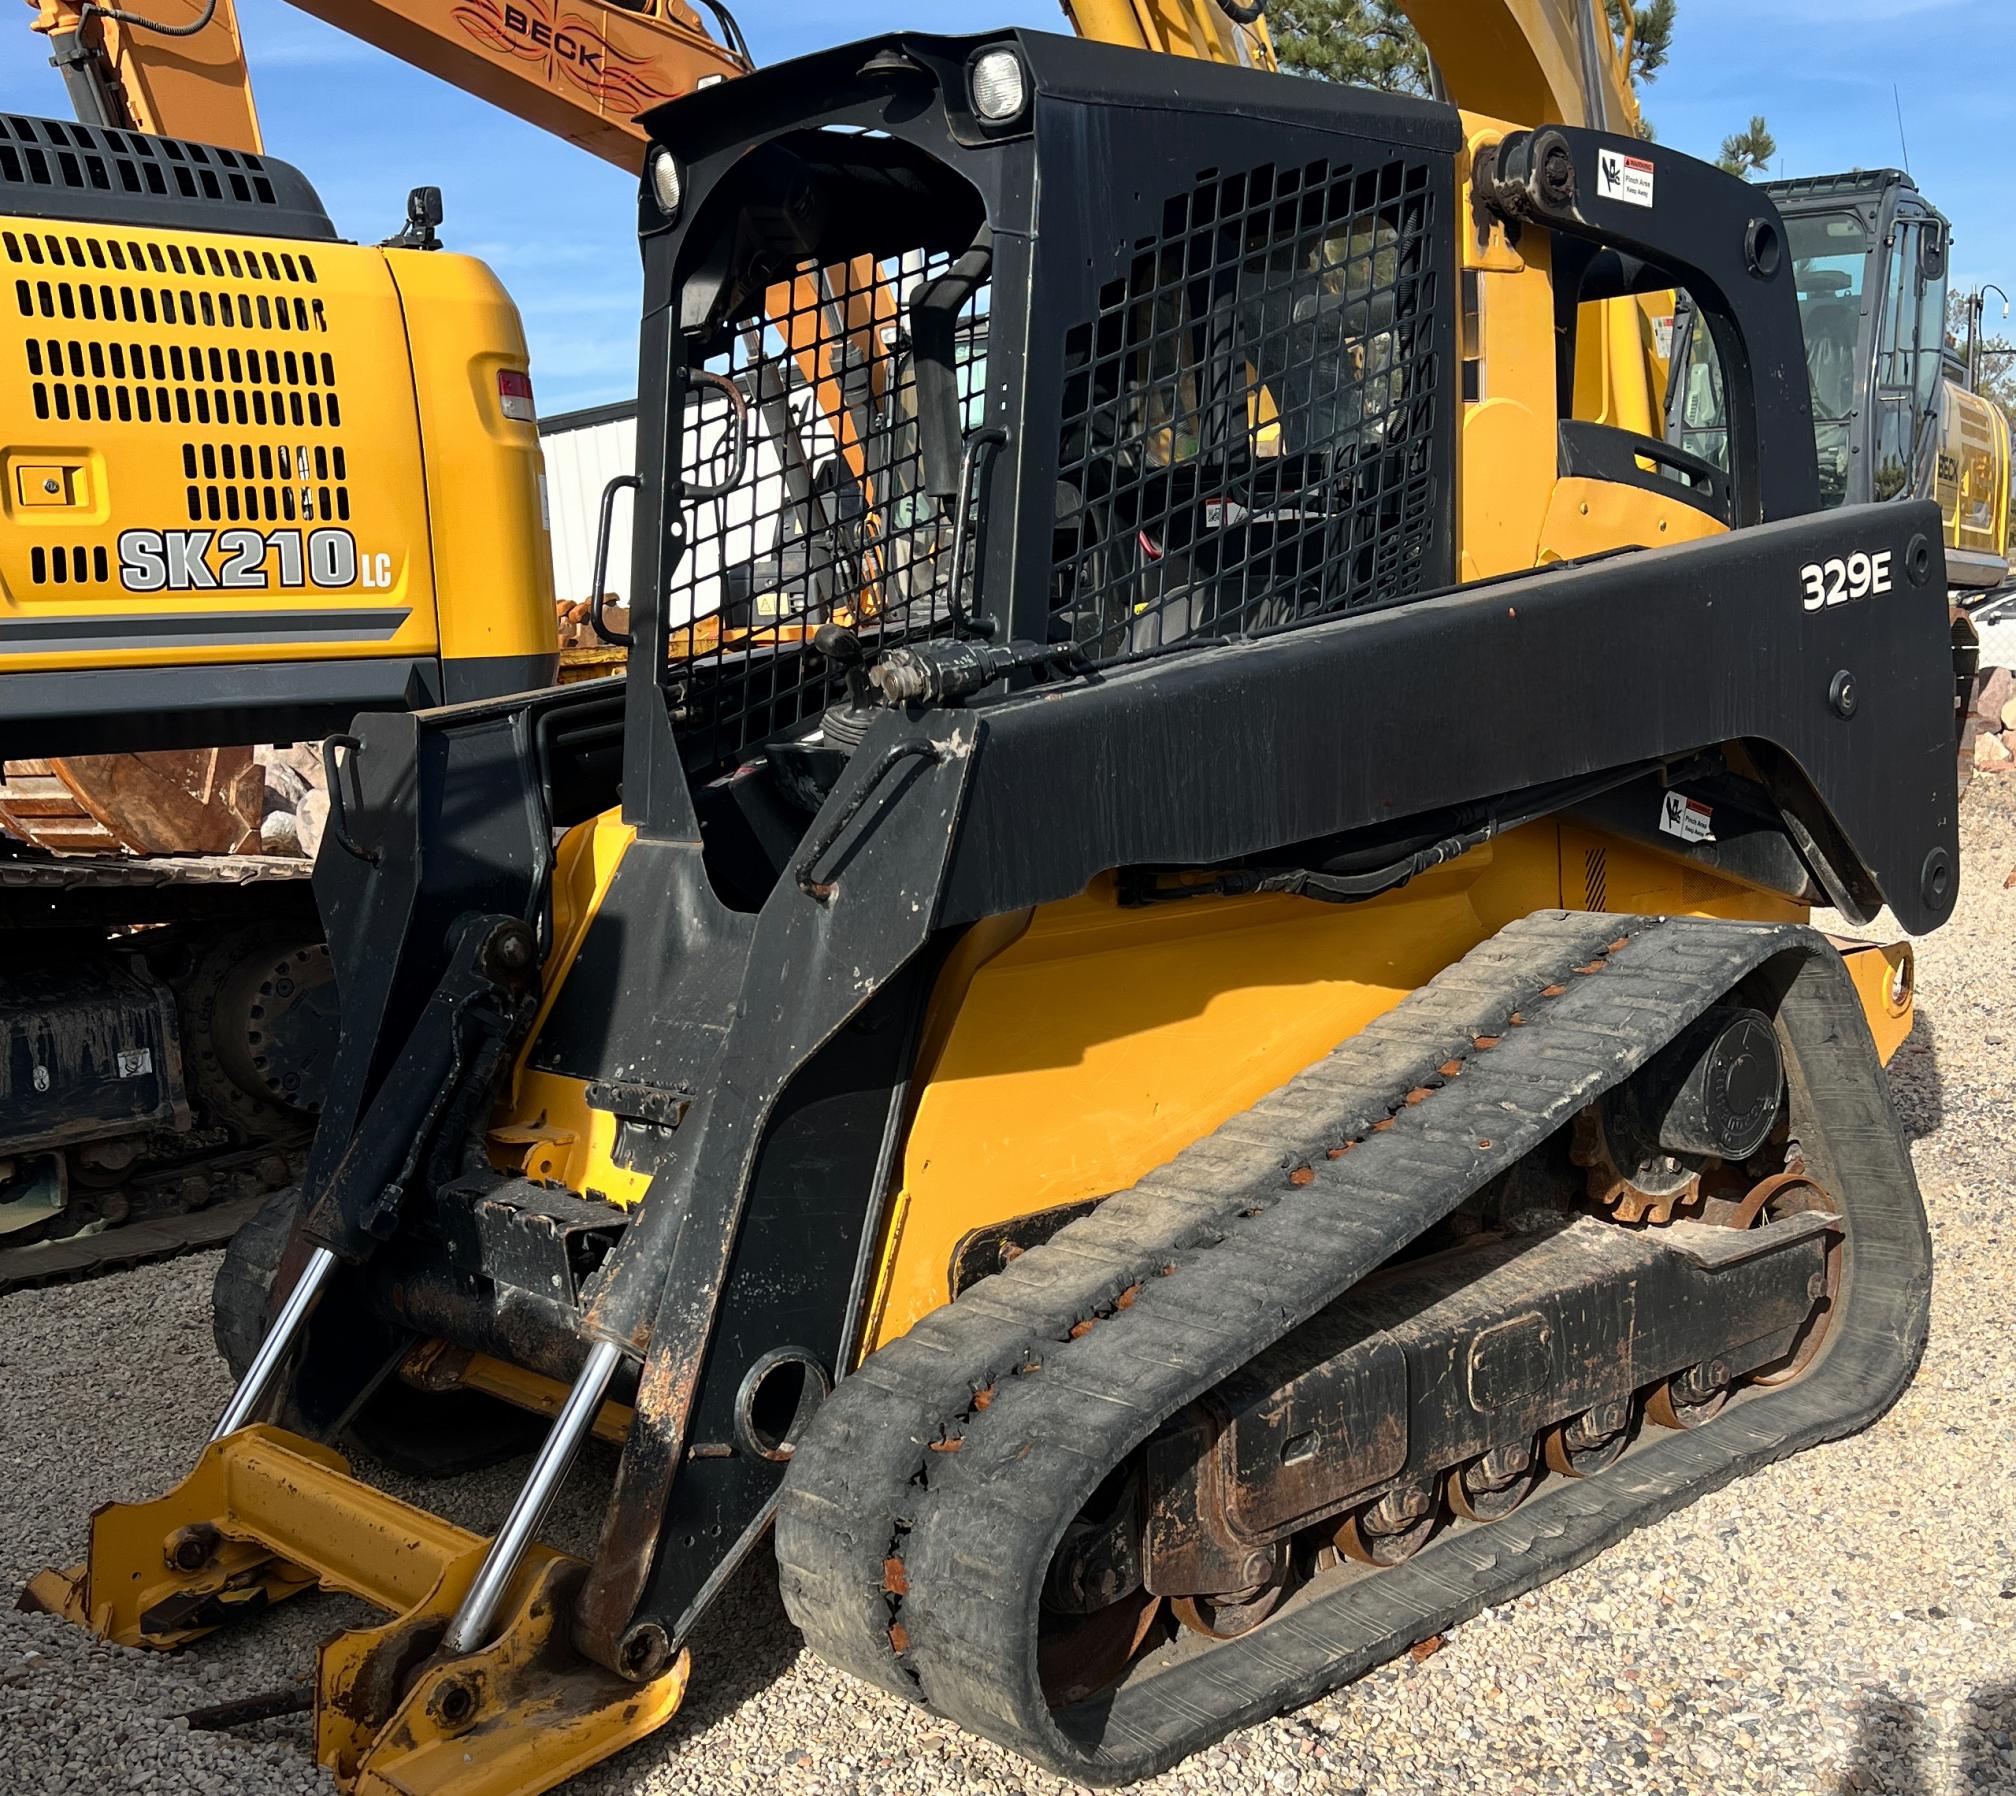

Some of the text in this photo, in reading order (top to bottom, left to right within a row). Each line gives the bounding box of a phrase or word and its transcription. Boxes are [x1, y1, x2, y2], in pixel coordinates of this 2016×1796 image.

[505, 4, 603, 75] BECK
[117, 527, 391, 593] SK210 LC
[1799, 548, 1893, 612] 329E
